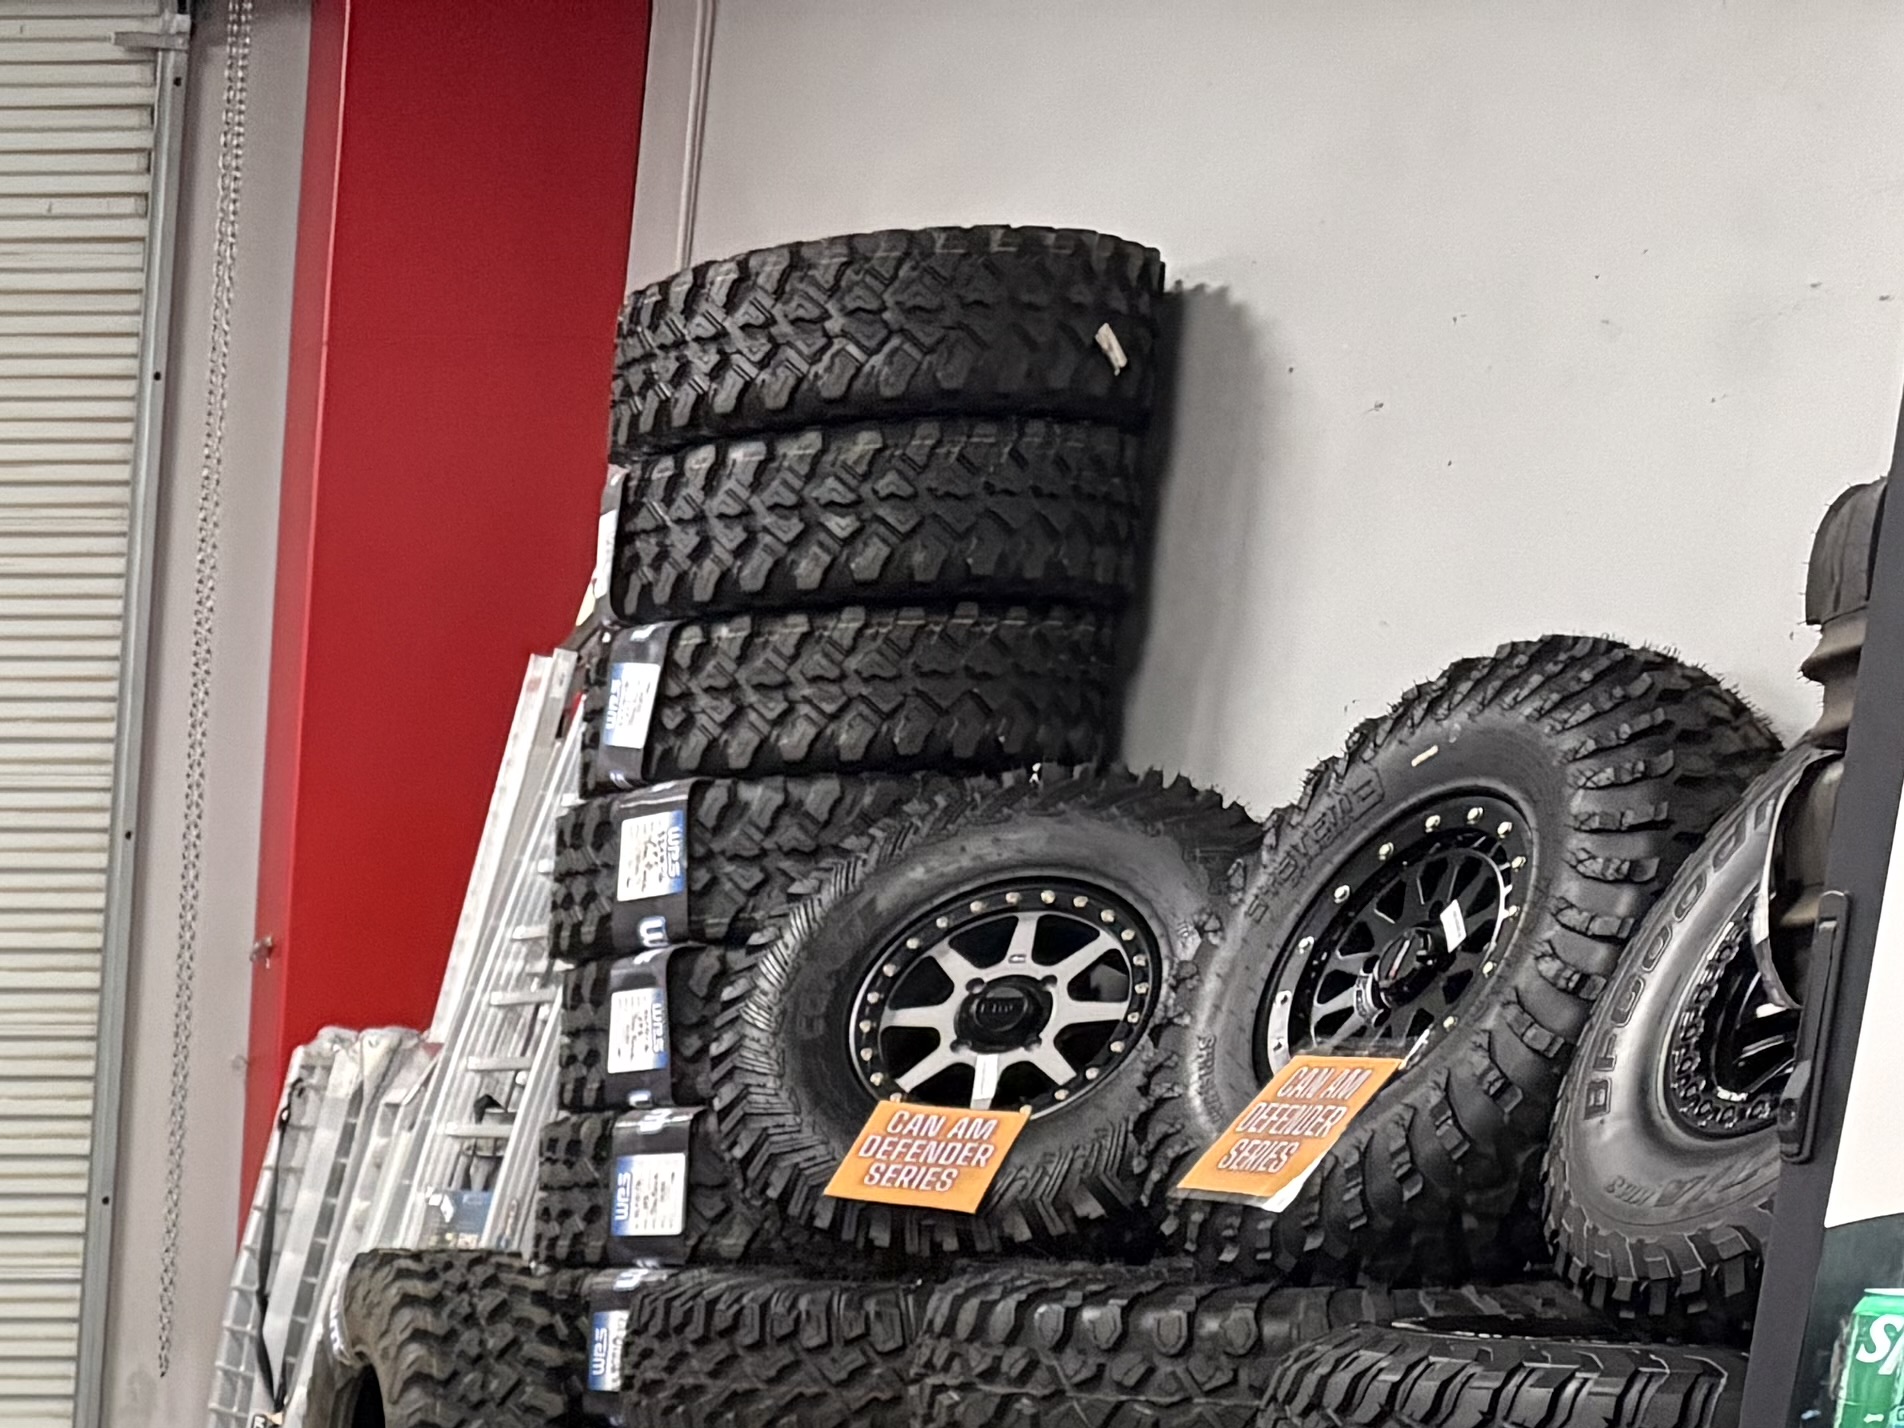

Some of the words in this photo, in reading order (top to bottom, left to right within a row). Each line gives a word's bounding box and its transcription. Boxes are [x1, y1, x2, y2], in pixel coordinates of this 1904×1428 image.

[667, 826, 683, 879] WPS
[651, 1002, 665, 1054] WPS
[1278, 1064, 1320, 1098] CAN
[1320, 1067, 1373, 1102] AM
[886, 1110, 945, 1137] CAN
[947, 1116, 996, 1141] AM
[1234, 1102, 1350, 1137] DEFENDER
[858, 1135, 995, 1168] DEFENDER
[1216, 1136, 1296, 1173] SERIES
[864, 1161, 959, 1193] SERIES
[614, 1171, 633, 1222] WPS
[592, 1327, 608, 1376] WPS
